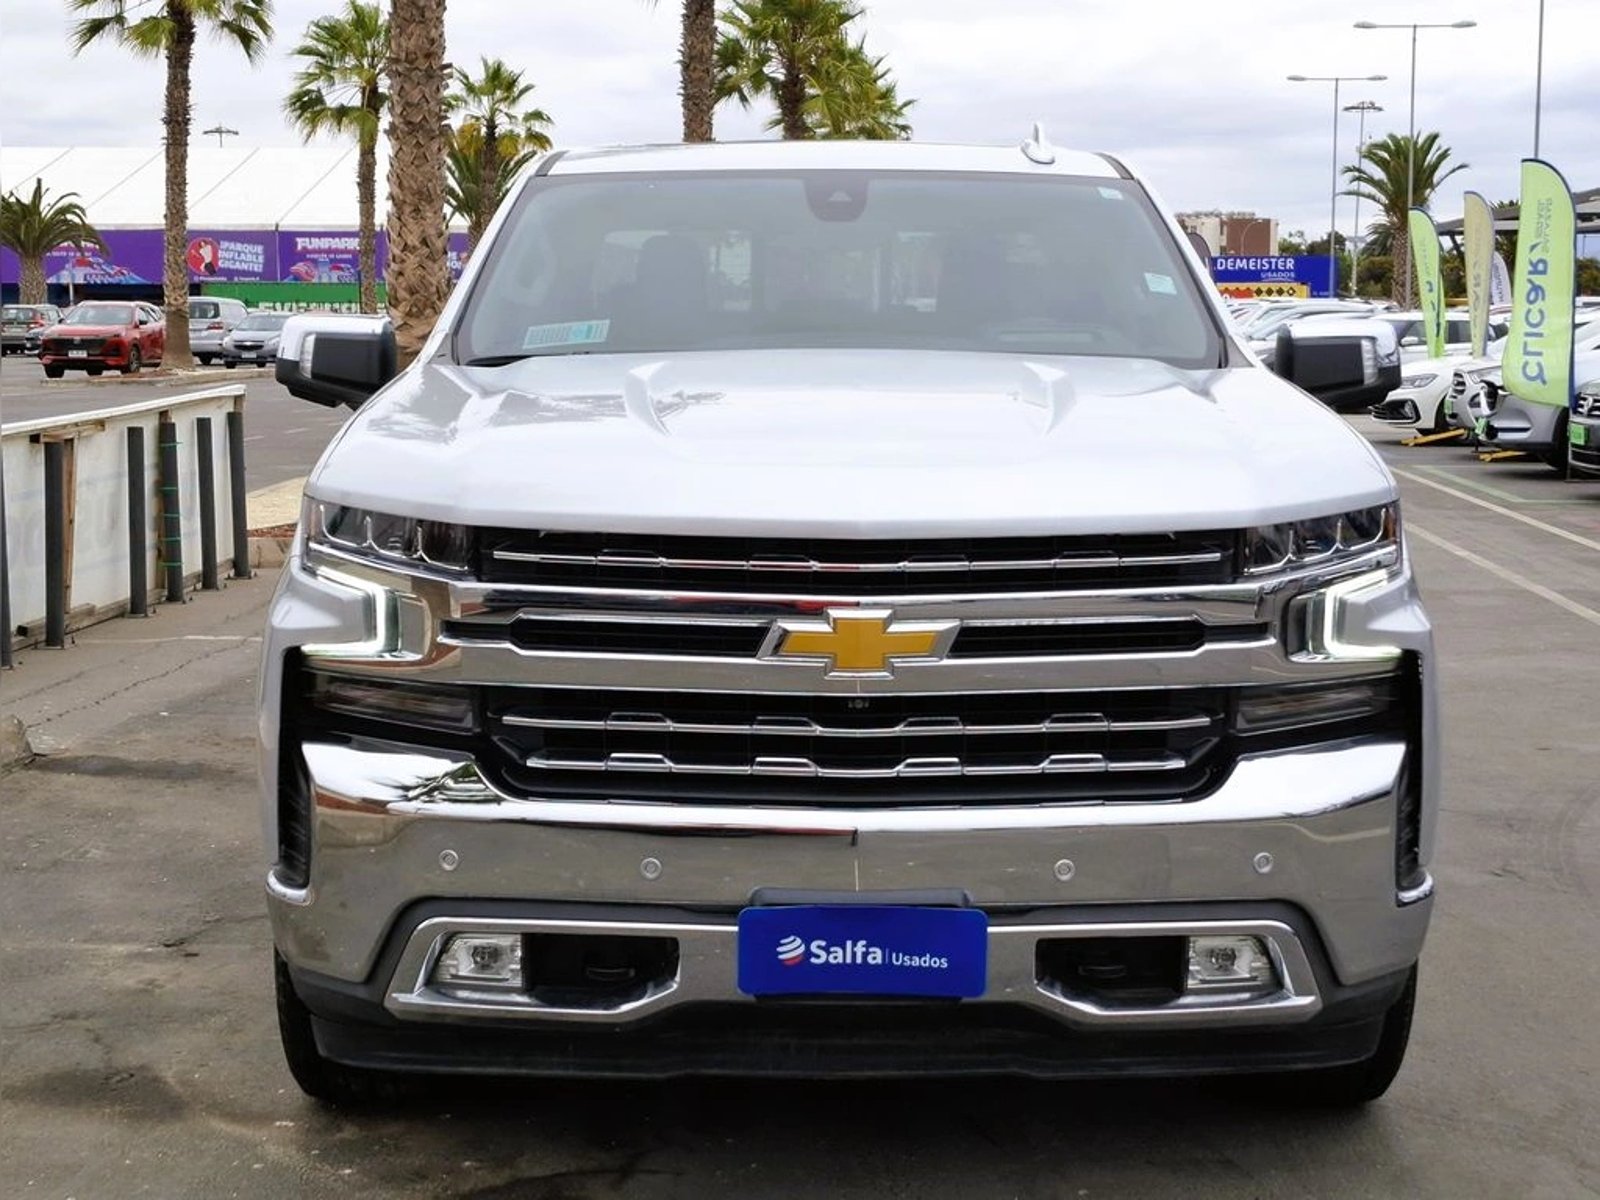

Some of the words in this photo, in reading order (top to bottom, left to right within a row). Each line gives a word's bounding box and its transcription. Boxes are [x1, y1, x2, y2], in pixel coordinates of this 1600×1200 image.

[218, 249, 264, 263] INFLABLE
[1213, 258, 1295, 271] DEMEISTER
[1260, 271, 1296, 279] USADOS
[809, 940, 883, 965] Salfa
[891, 952, 949, 969] Usados
